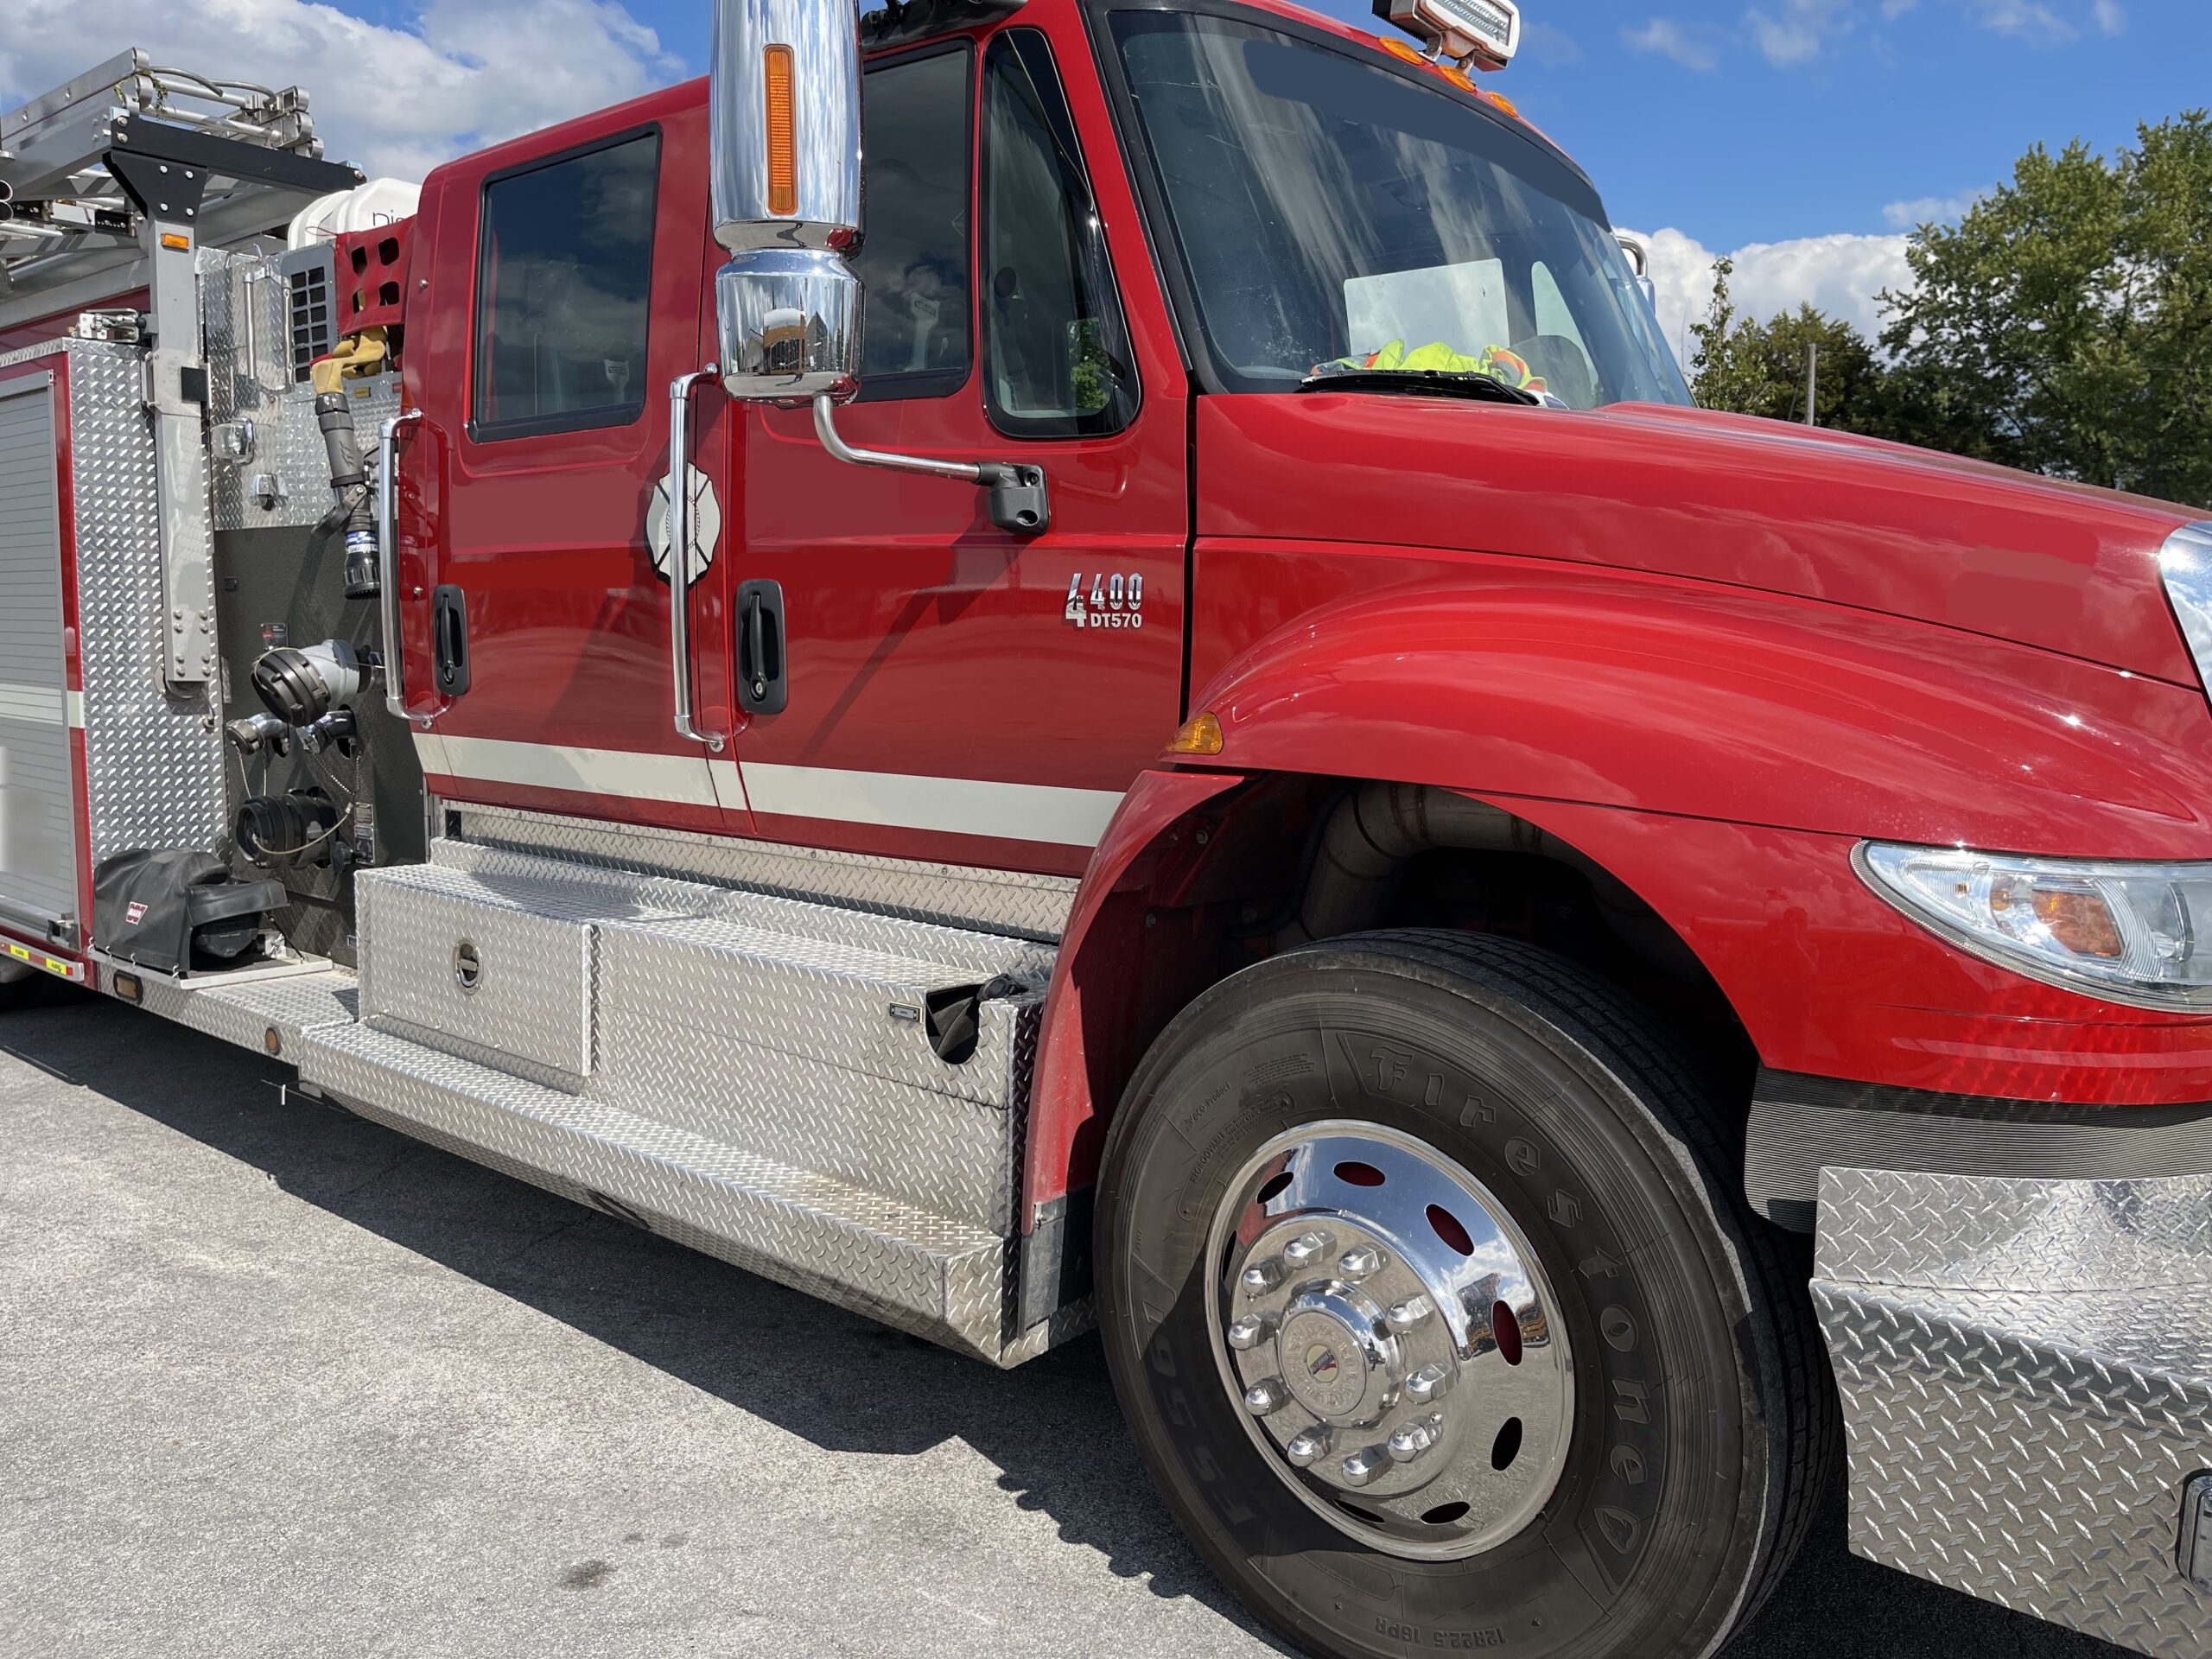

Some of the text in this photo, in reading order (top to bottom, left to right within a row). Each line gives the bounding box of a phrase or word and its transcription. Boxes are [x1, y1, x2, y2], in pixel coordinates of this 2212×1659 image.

[1065, 573, 1142, 627] 4400
[1090, 613, 1142, 628] DT570
[1370, 1046, 1651, 1484] Firestone
[1375, 1616, 1507, 1649] 12R22.5 16PR
